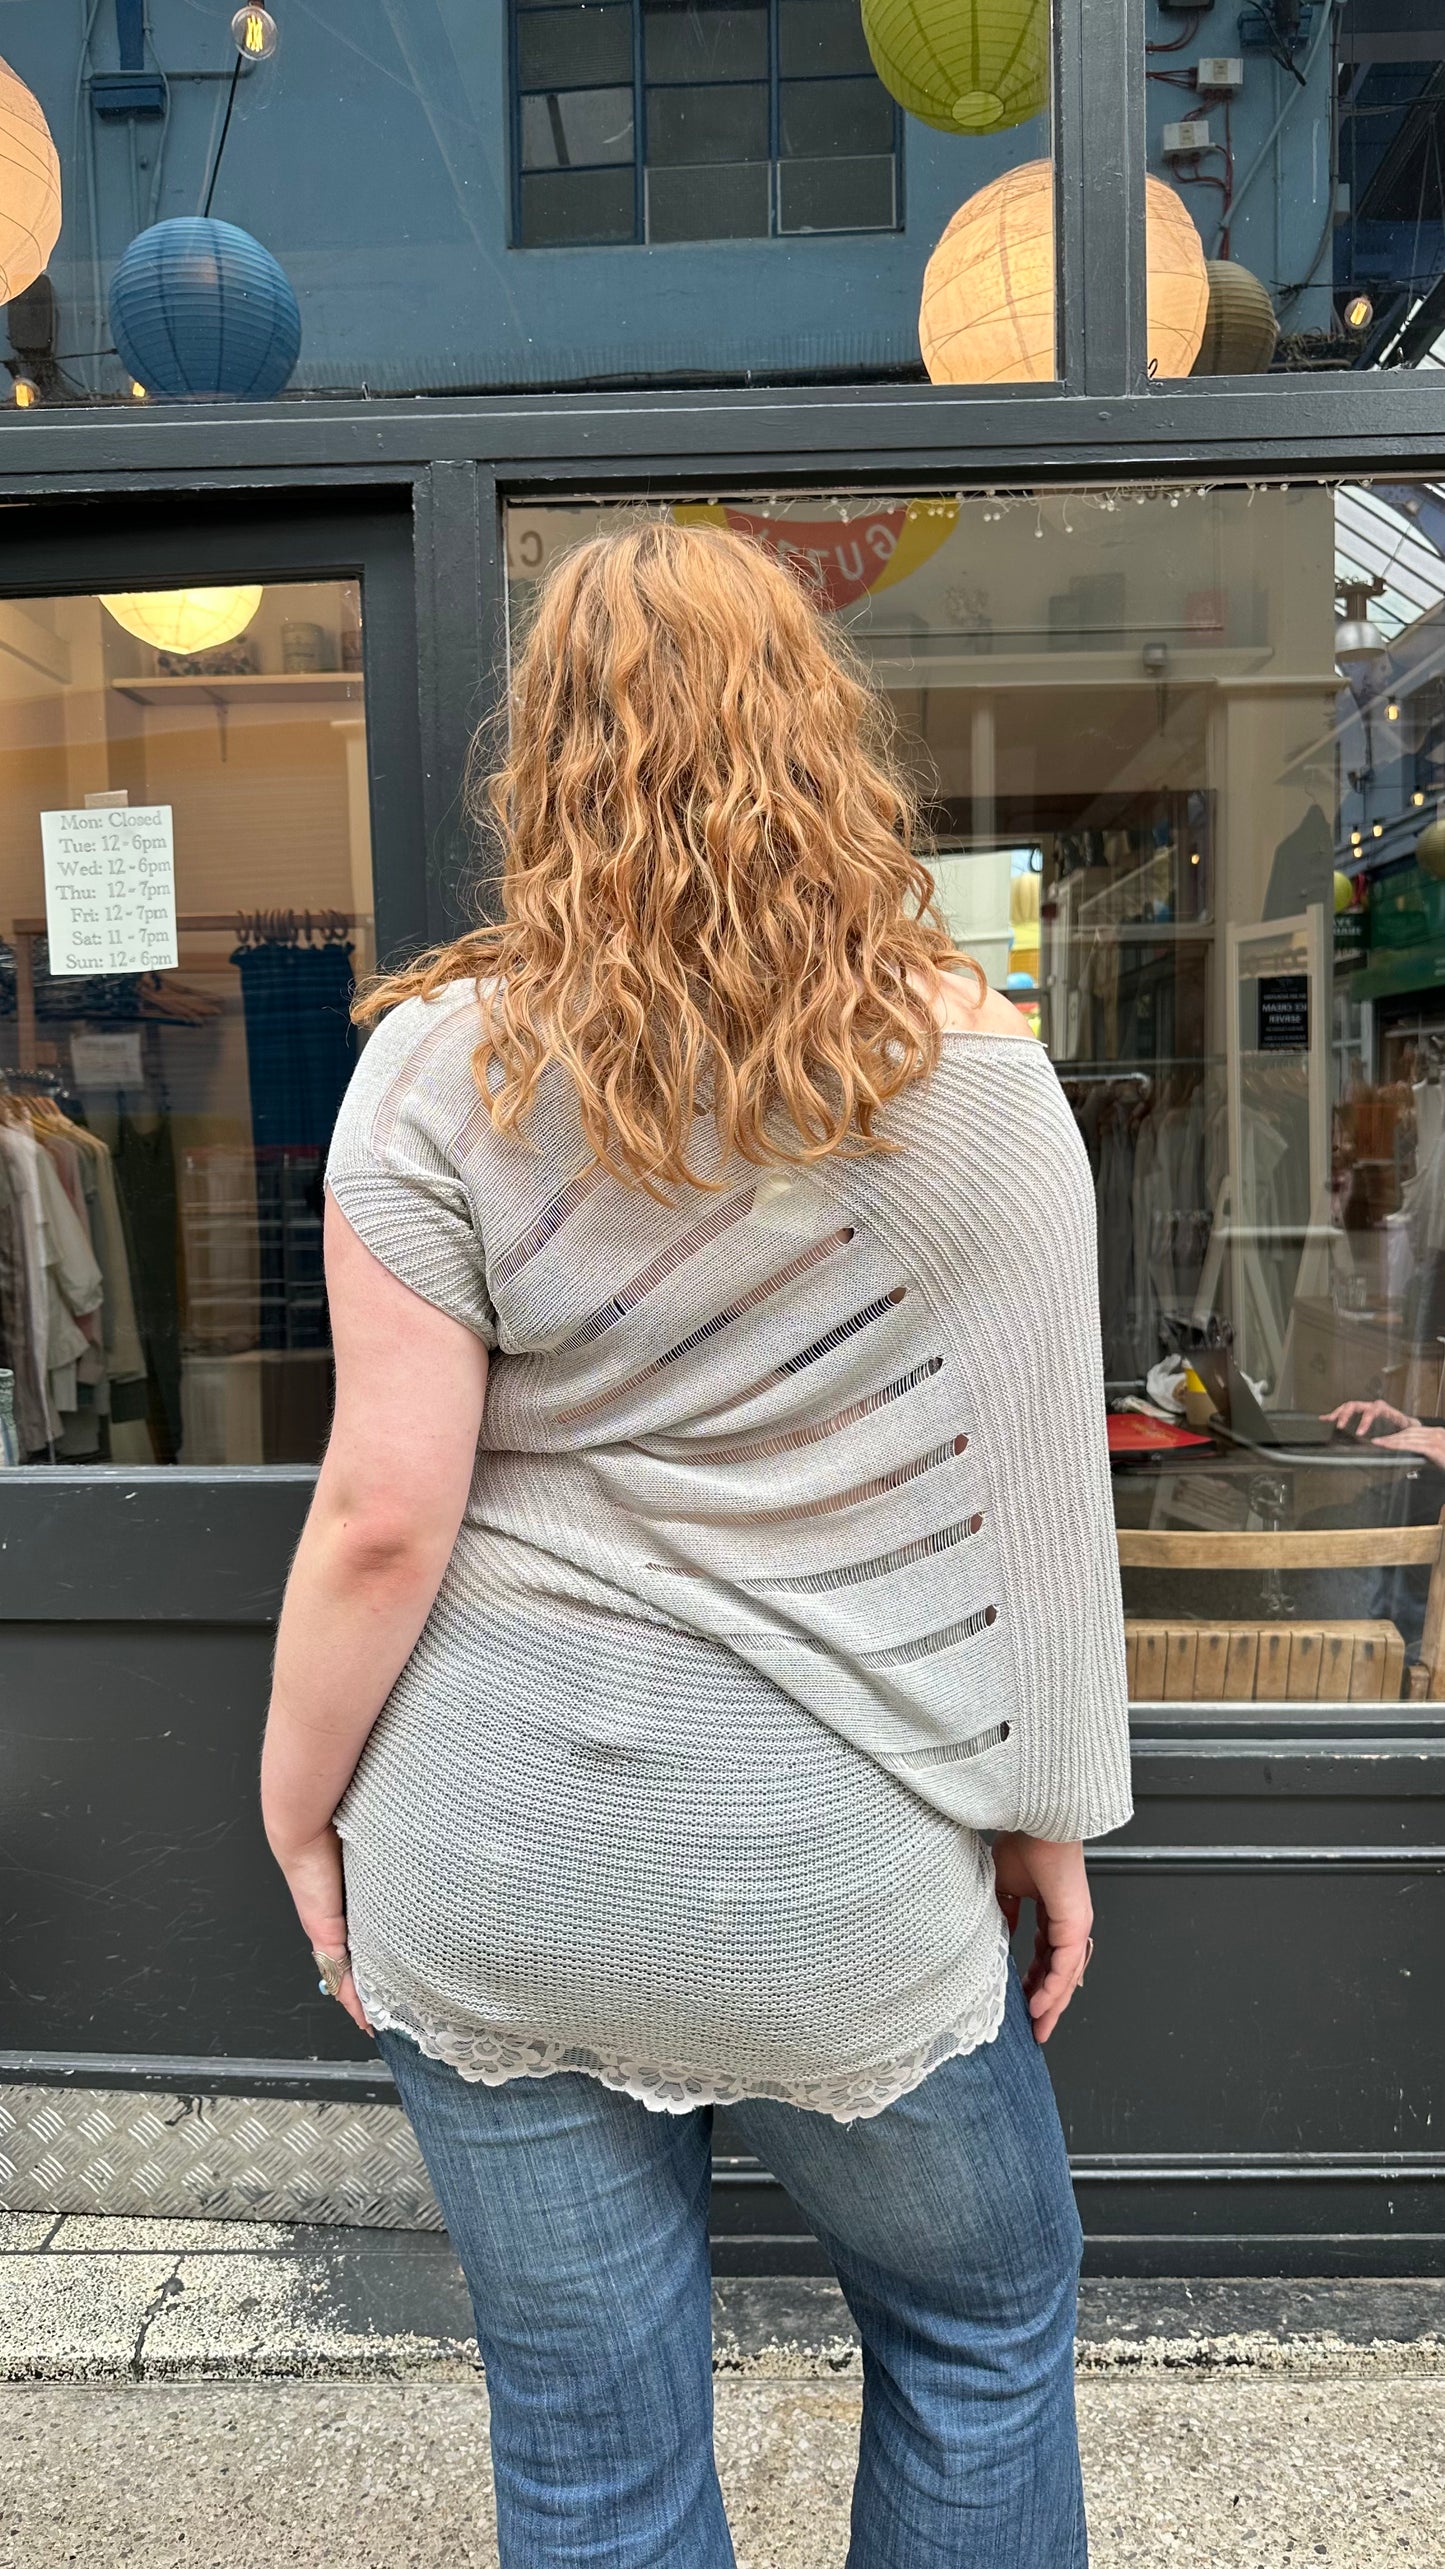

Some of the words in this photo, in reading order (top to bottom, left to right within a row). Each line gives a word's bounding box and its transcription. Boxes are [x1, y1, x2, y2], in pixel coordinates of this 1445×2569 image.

[60, 815, 103, 830] Mon:
[108, 811, 162, 827] Closed
[59, 838, 96, 853] Tue:
[101, 835, 120, 851] 12
[132, 835, 167, 853] 6pm
[57, 861, 102, 876] Wed:
[108, 859, 126, 875] 12
[138, 858, 171, 877] 6pm
[55, 885, 96, 900] Thu:
[107, 881, 126, 898] 12
[139, 881, 171, 900] 7pm
[71, 908, 99, 922] Fri:
[105, 905, 123, 921] 12
[136, 906, 168, 924] 7pm
[72, 931, 102, 946] Sat:
[108, 930, 122, 945] 11
[139, 929, 170, 947] 7pm
[66, 954, 103, 969] Sun:
[109, 951, 127, 968] 12
[140, 951, 172, 969] 6pm
